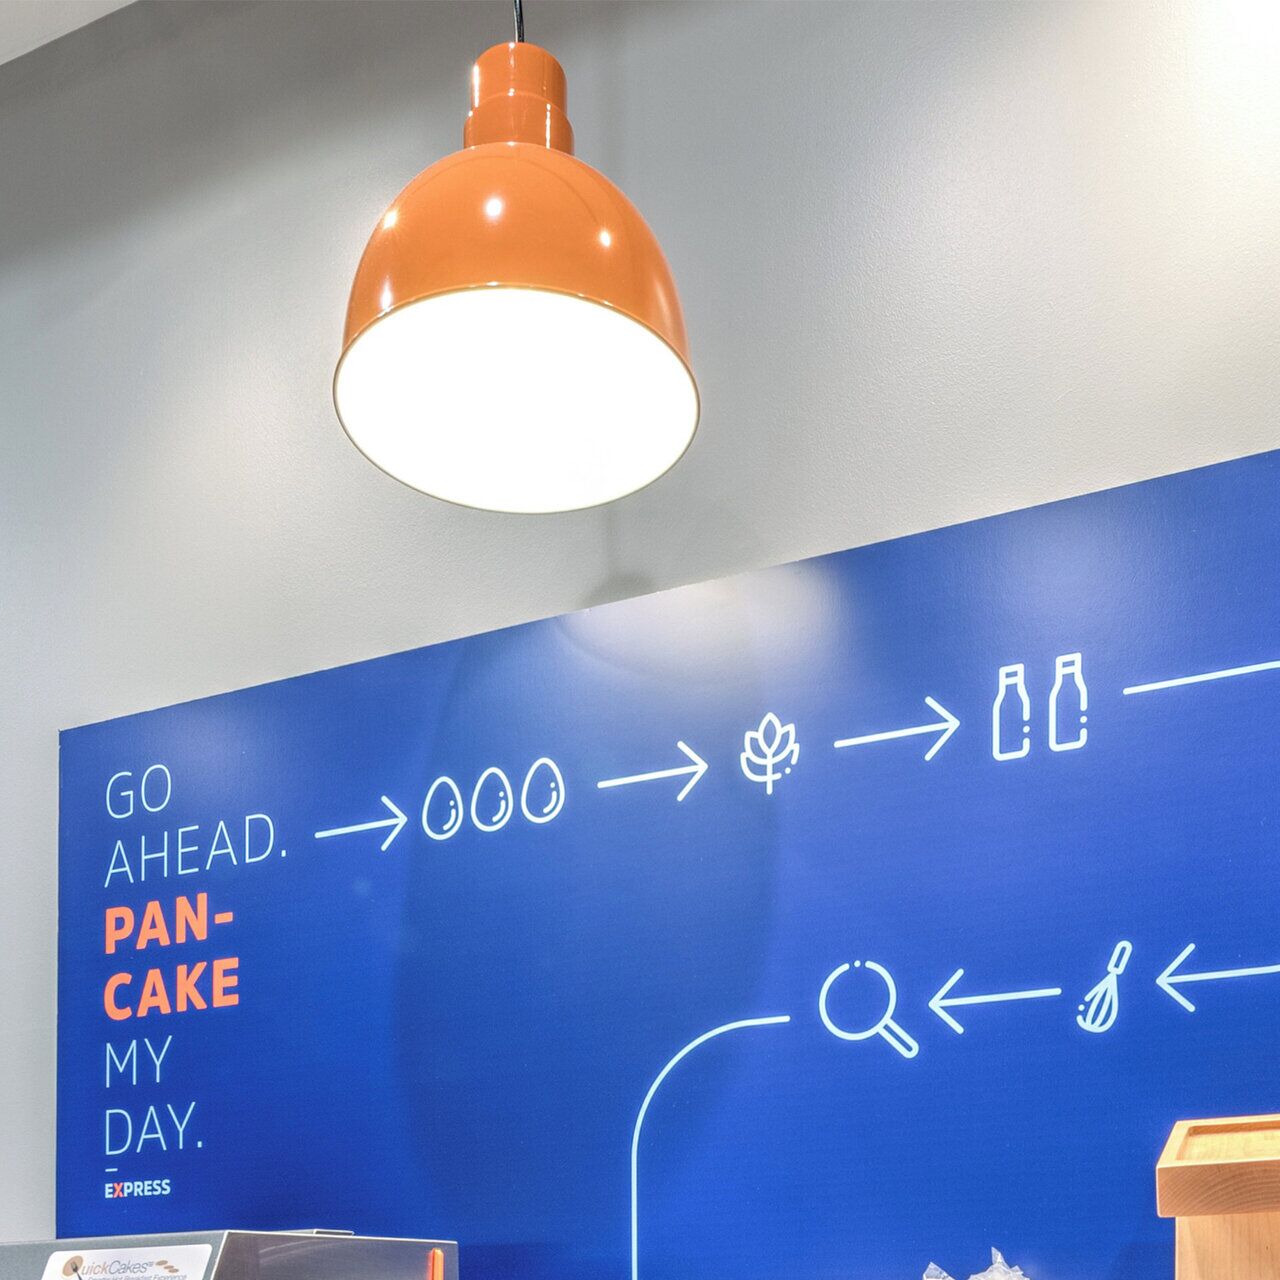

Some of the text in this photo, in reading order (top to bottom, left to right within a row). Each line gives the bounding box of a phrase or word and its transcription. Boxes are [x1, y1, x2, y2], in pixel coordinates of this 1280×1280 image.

[105, 763, 172, 819] GO
[104, 813, 287, 888] AHEAD.
[104, 892, 234, 955] PAN-
[103, 956, 239, 1021] CAKE
[105, 1035, 172, 1088] MY
[105, 1101, 203, 1156] DAY.
[104, 1178, 171, 1199] EXPRESS
